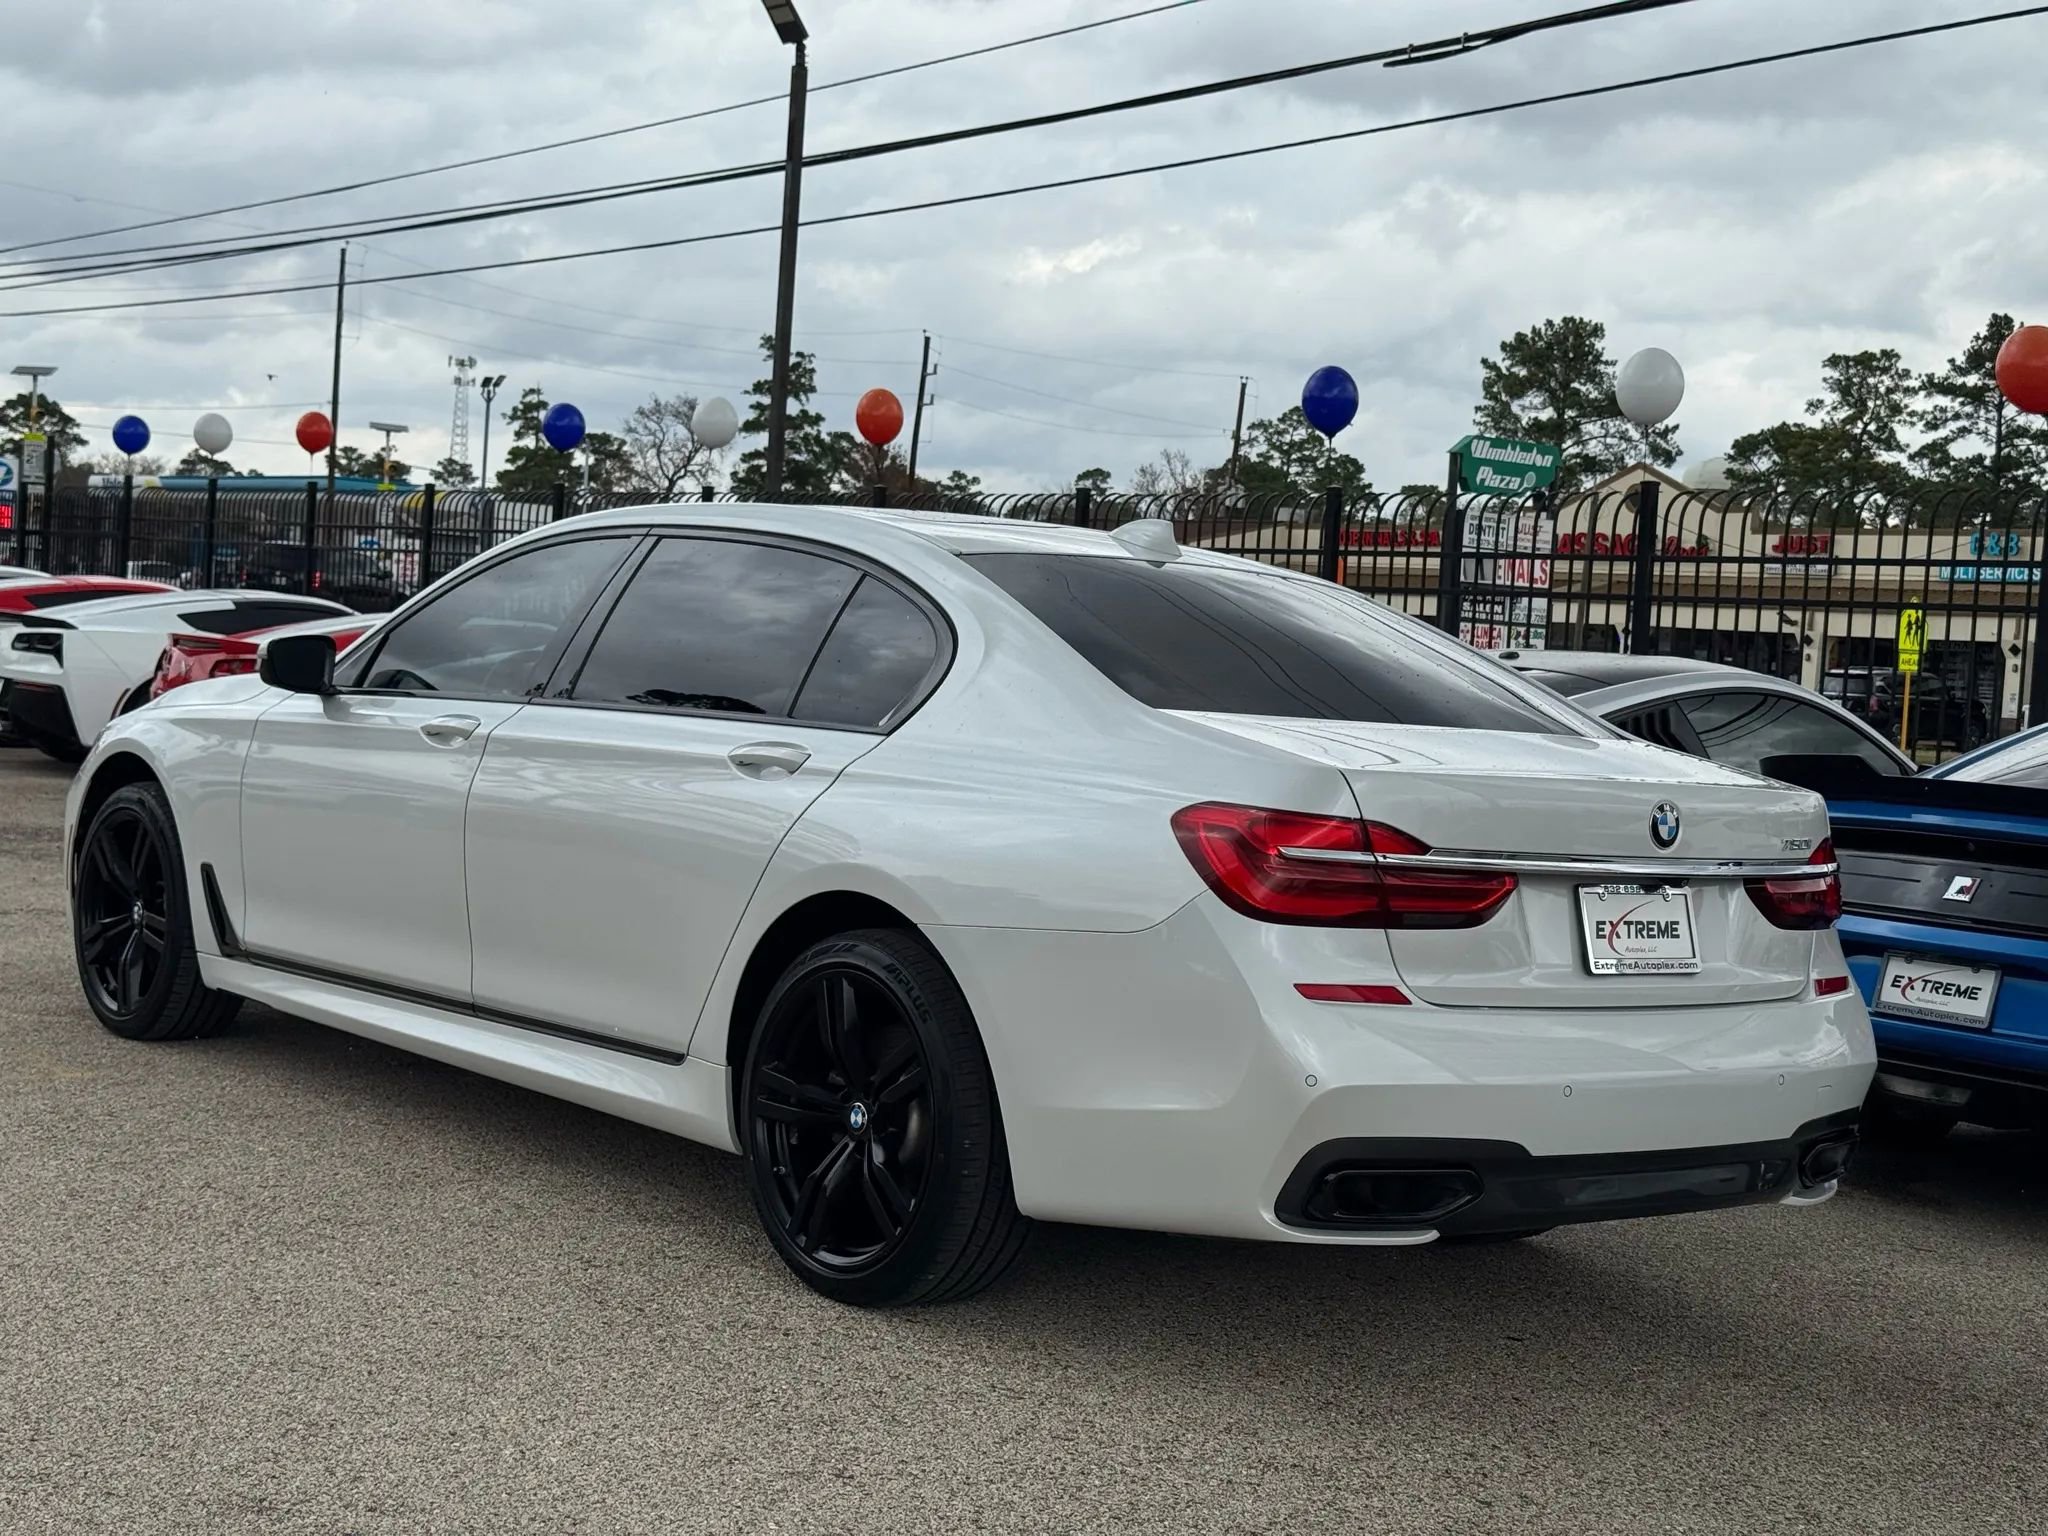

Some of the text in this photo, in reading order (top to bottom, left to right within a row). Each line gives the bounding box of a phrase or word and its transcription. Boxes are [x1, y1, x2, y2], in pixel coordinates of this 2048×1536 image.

[1471, 439, 1553, 468] Wimbledon
[1476, 466, 1521, 490] Plaza
[1469, 523, 1506, 539] DENTIT
[1771, 535, 1830, 554] JUST
[1595, 920, 1680, 940] EXTREME
[1593, 960, 1698, 972] ExtremeAutoplex.com
[1890, 974, 1983, 1001] EXTREME
[1875, 1003, 1985, 1026] ExtremeAutoplex.com
